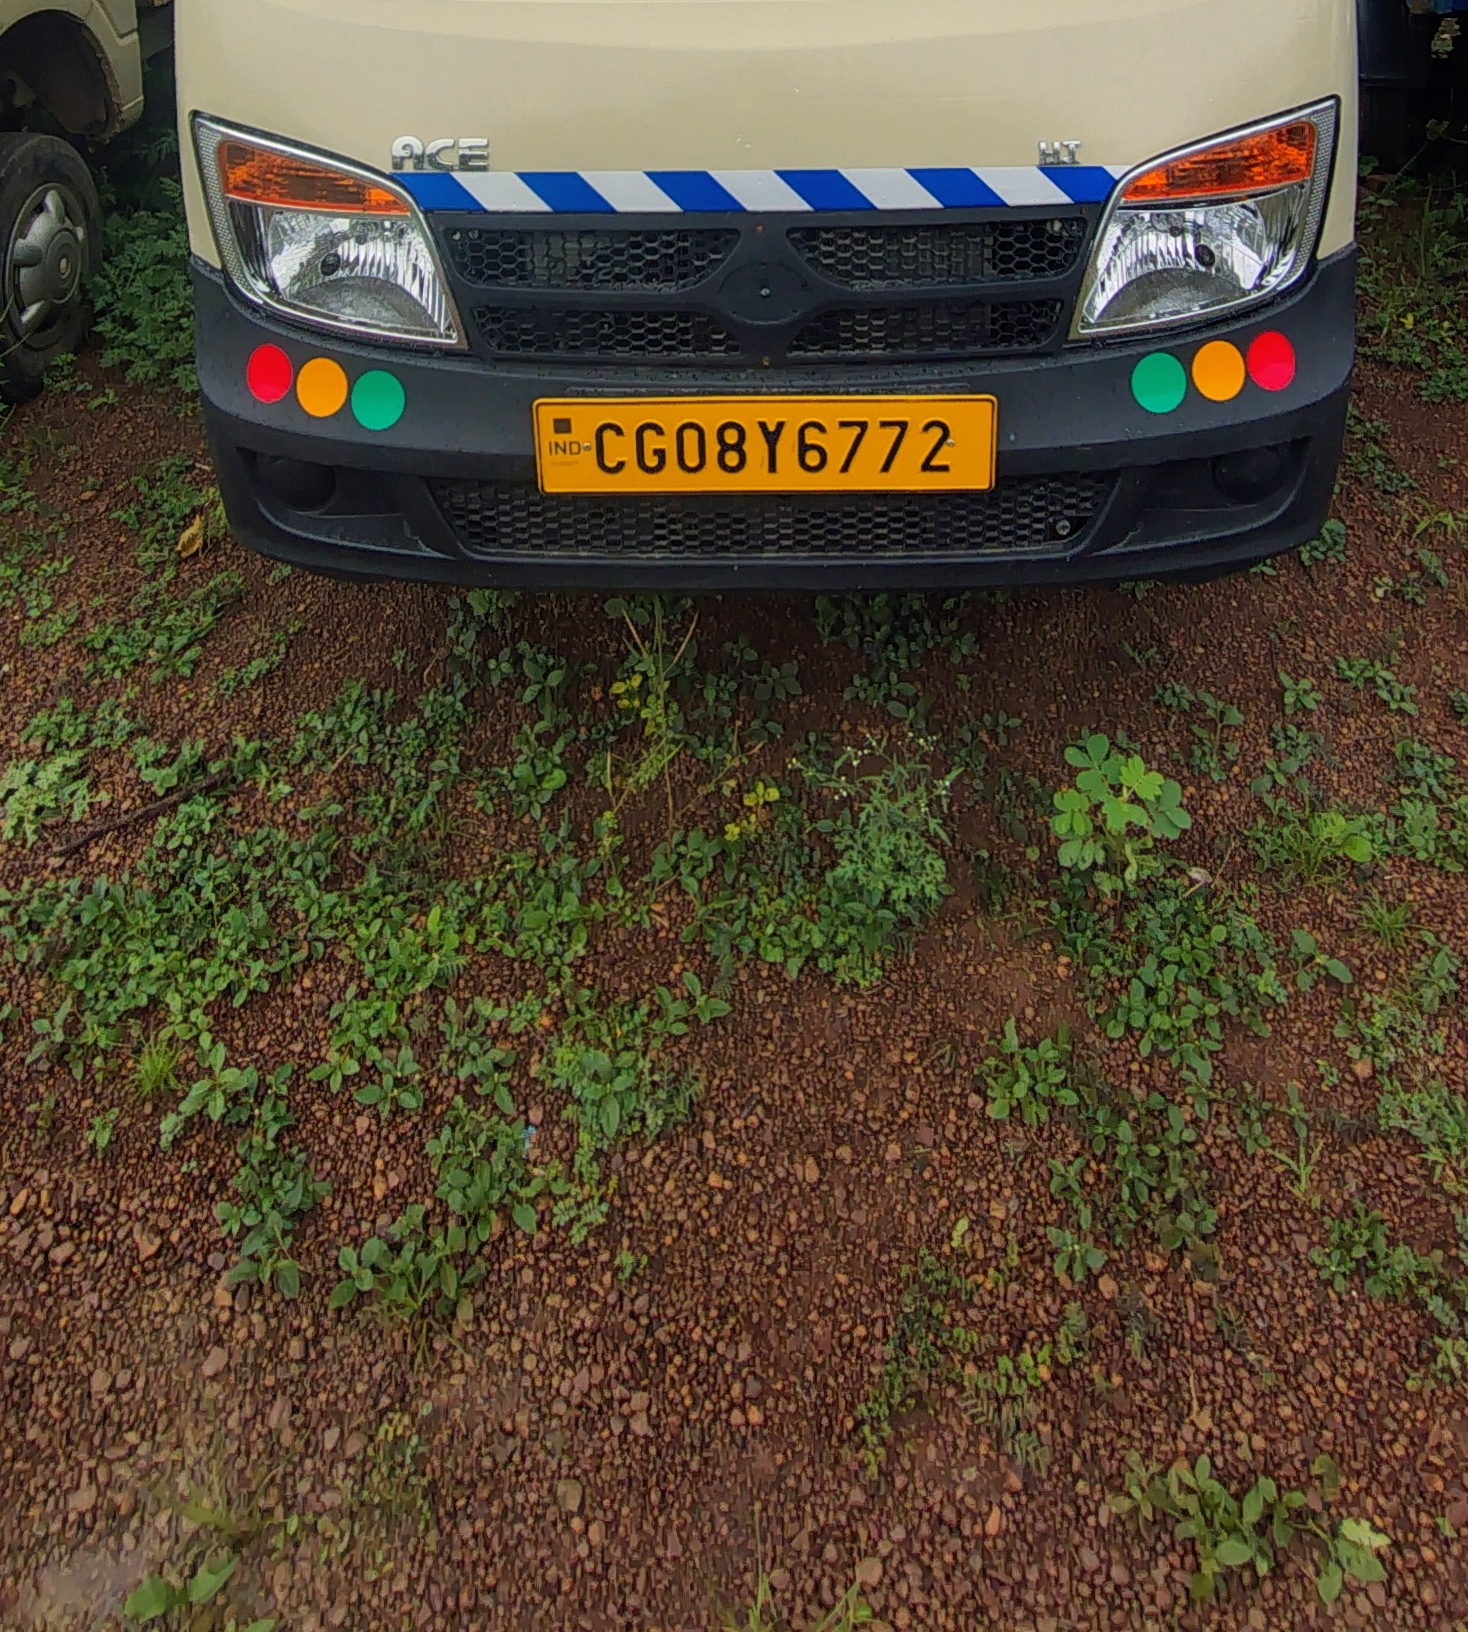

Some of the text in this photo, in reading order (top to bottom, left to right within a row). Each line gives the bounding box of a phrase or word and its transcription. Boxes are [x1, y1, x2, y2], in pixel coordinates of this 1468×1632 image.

[391, 135, 490, 172] ACE
[1038, 139, 1082, 166] HT
[548, 440, 581, 456] IND
[594, 419, 952, 475] CG08Y6772
